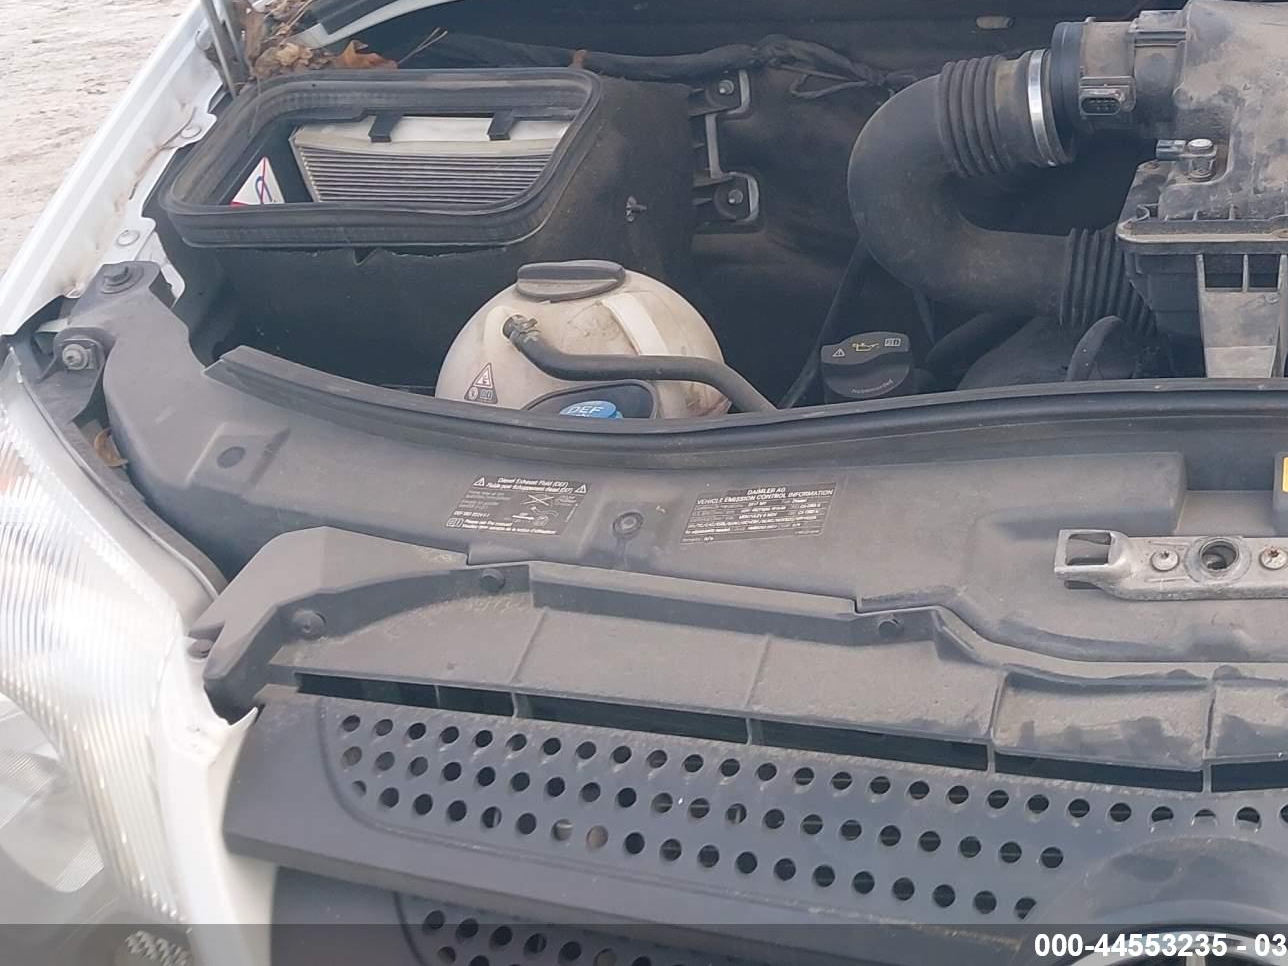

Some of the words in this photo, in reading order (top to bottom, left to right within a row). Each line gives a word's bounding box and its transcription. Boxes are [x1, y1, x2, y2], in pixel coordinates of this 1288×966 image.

[567, 405, 604, 414] DEF
[697, 496, 723, 505] VEHICLE
[724, 494, 756, 503] EMISSION
[757, 492, 787, 500] CONTROL
[788, 489, 834, 498] INFORMATION
